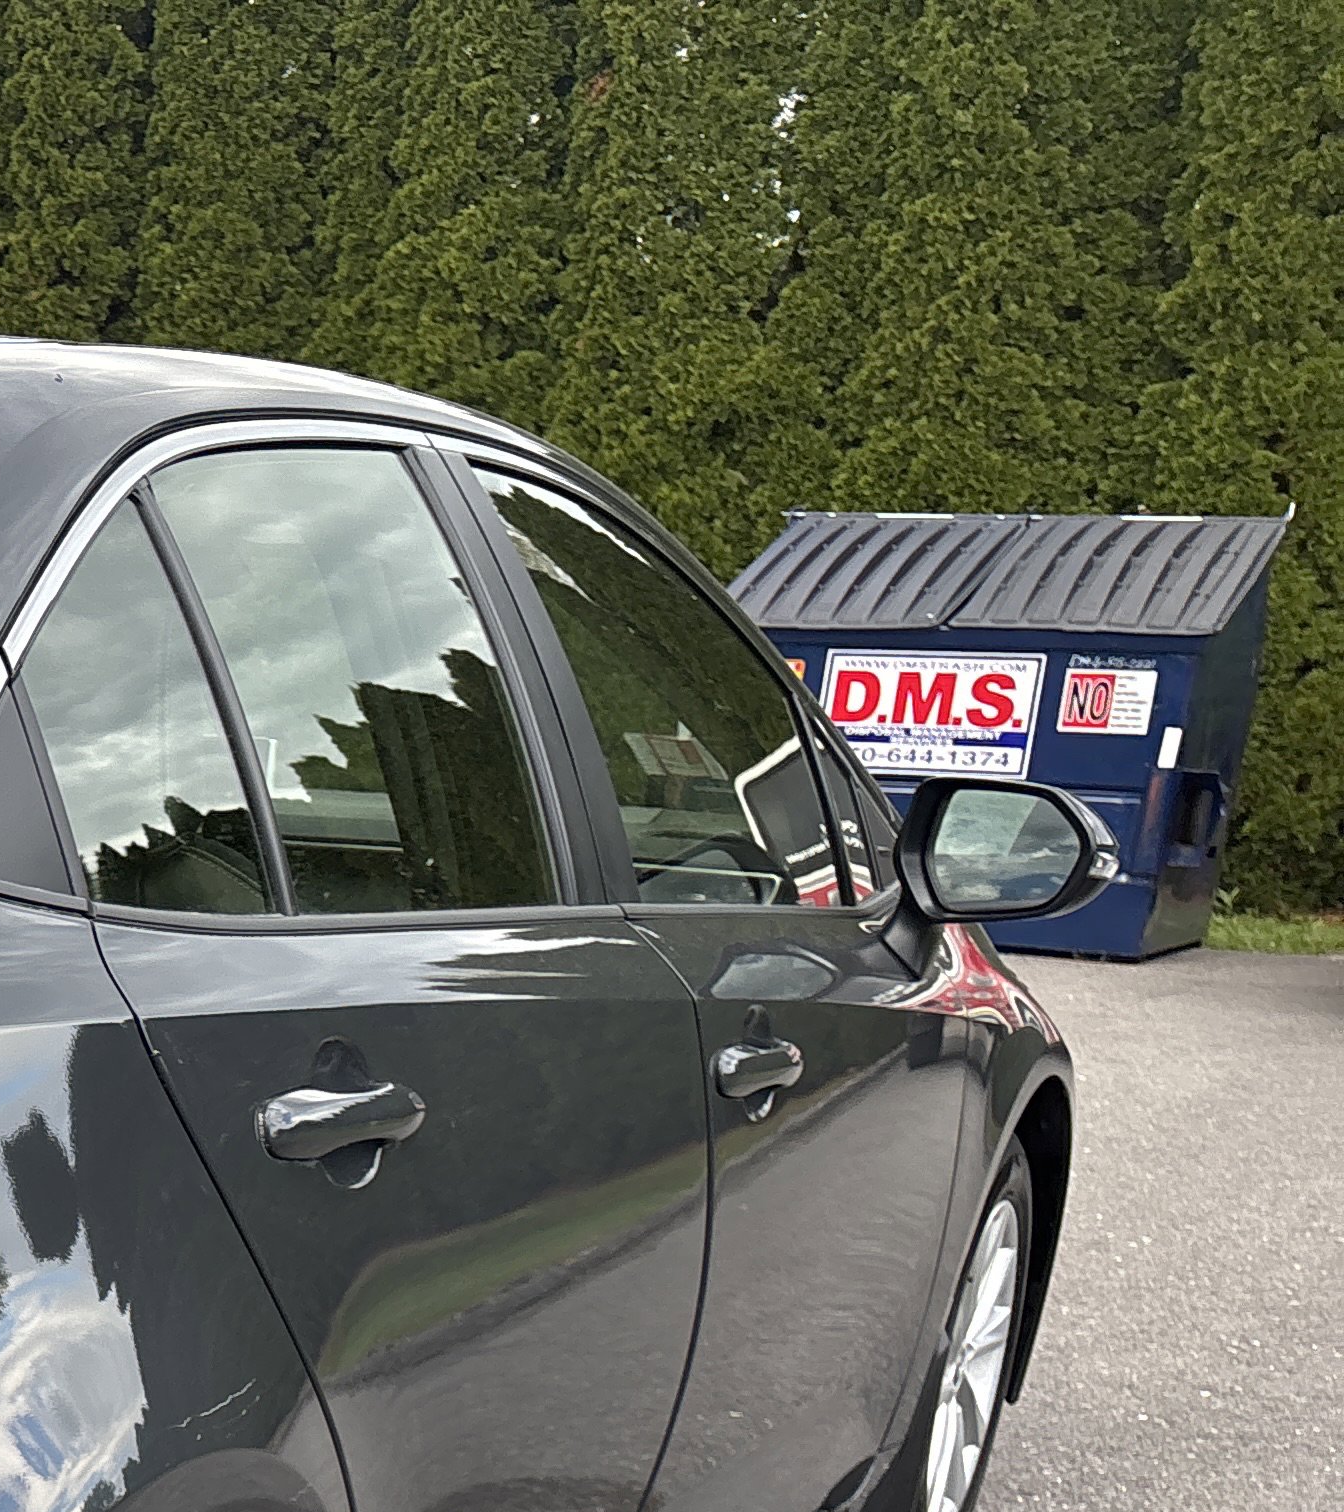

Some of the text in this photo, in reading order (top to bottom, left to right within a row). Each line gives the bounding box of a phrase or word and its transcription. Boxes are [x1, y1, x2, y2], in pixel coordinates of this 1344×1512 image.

[830, 670, 1023, 728] D.M.S.
[1066, 680, 1111, 723] NO
[853, 746, 1009, 768] 0-644-1374
